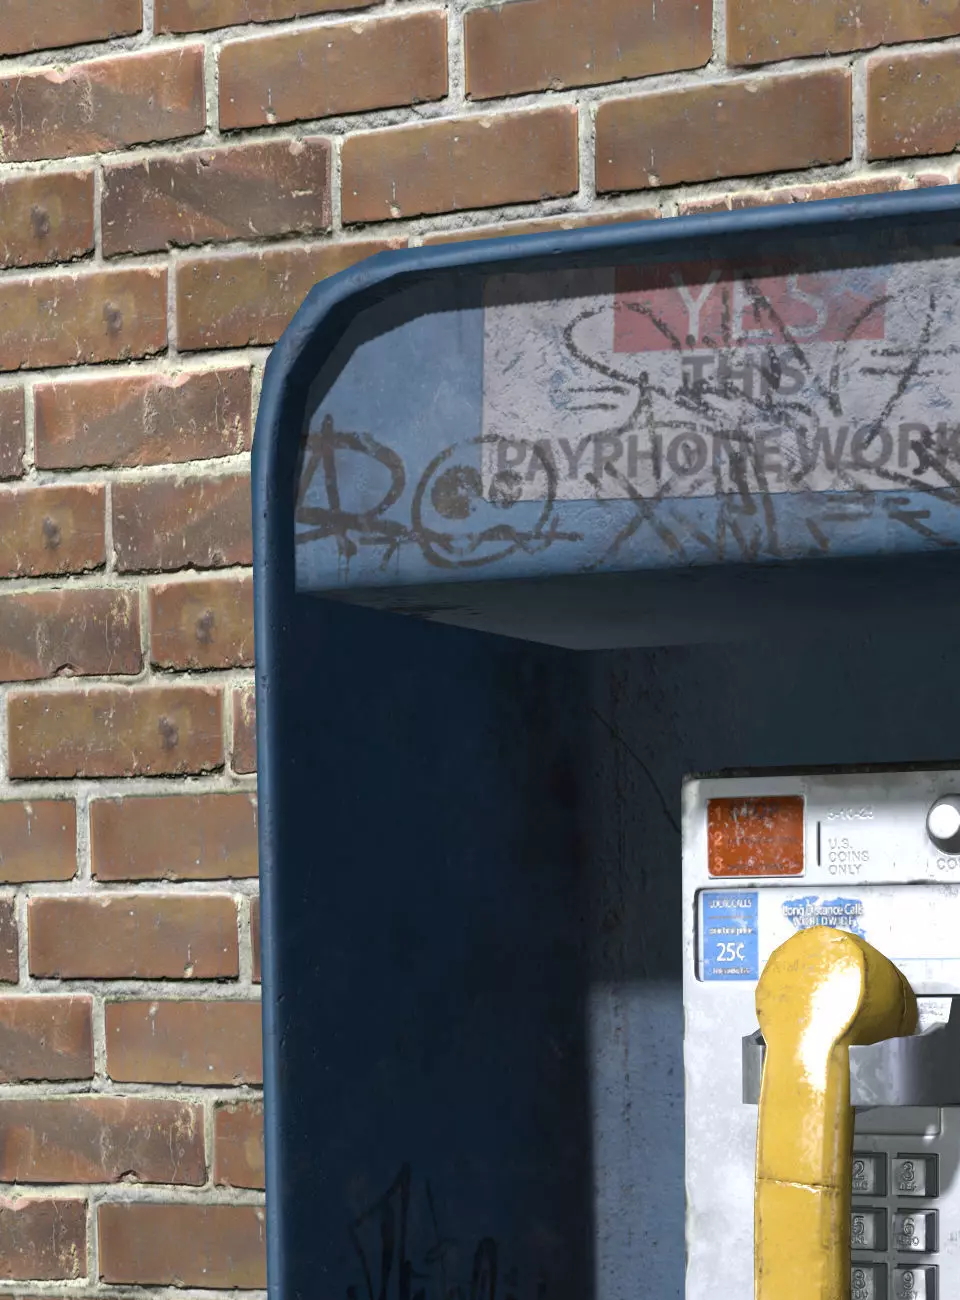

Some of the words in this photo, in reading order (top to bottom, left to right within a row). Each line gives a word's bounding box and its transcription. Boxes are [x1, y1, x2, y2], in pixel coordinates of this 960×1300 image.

[670, 264, 828, 343] YES
[682, 353, 806, 396] THIS
[496, 428, 784, 484] PAYPHONE
[828, 838, 852, 850] U.S.
[828, 850, 870, 863] COINS
[828, 864, 863, 876] ONLY
[852, 1160, 865, 1180] 2
[902, 1161, 915, 1181] 3
[853, 1215, 865, 1234] 5
[903, 1217, 915, 1236] 6
[854, 1269, 866, 1289] 8
[902, 1271, 915, 1290] 9
